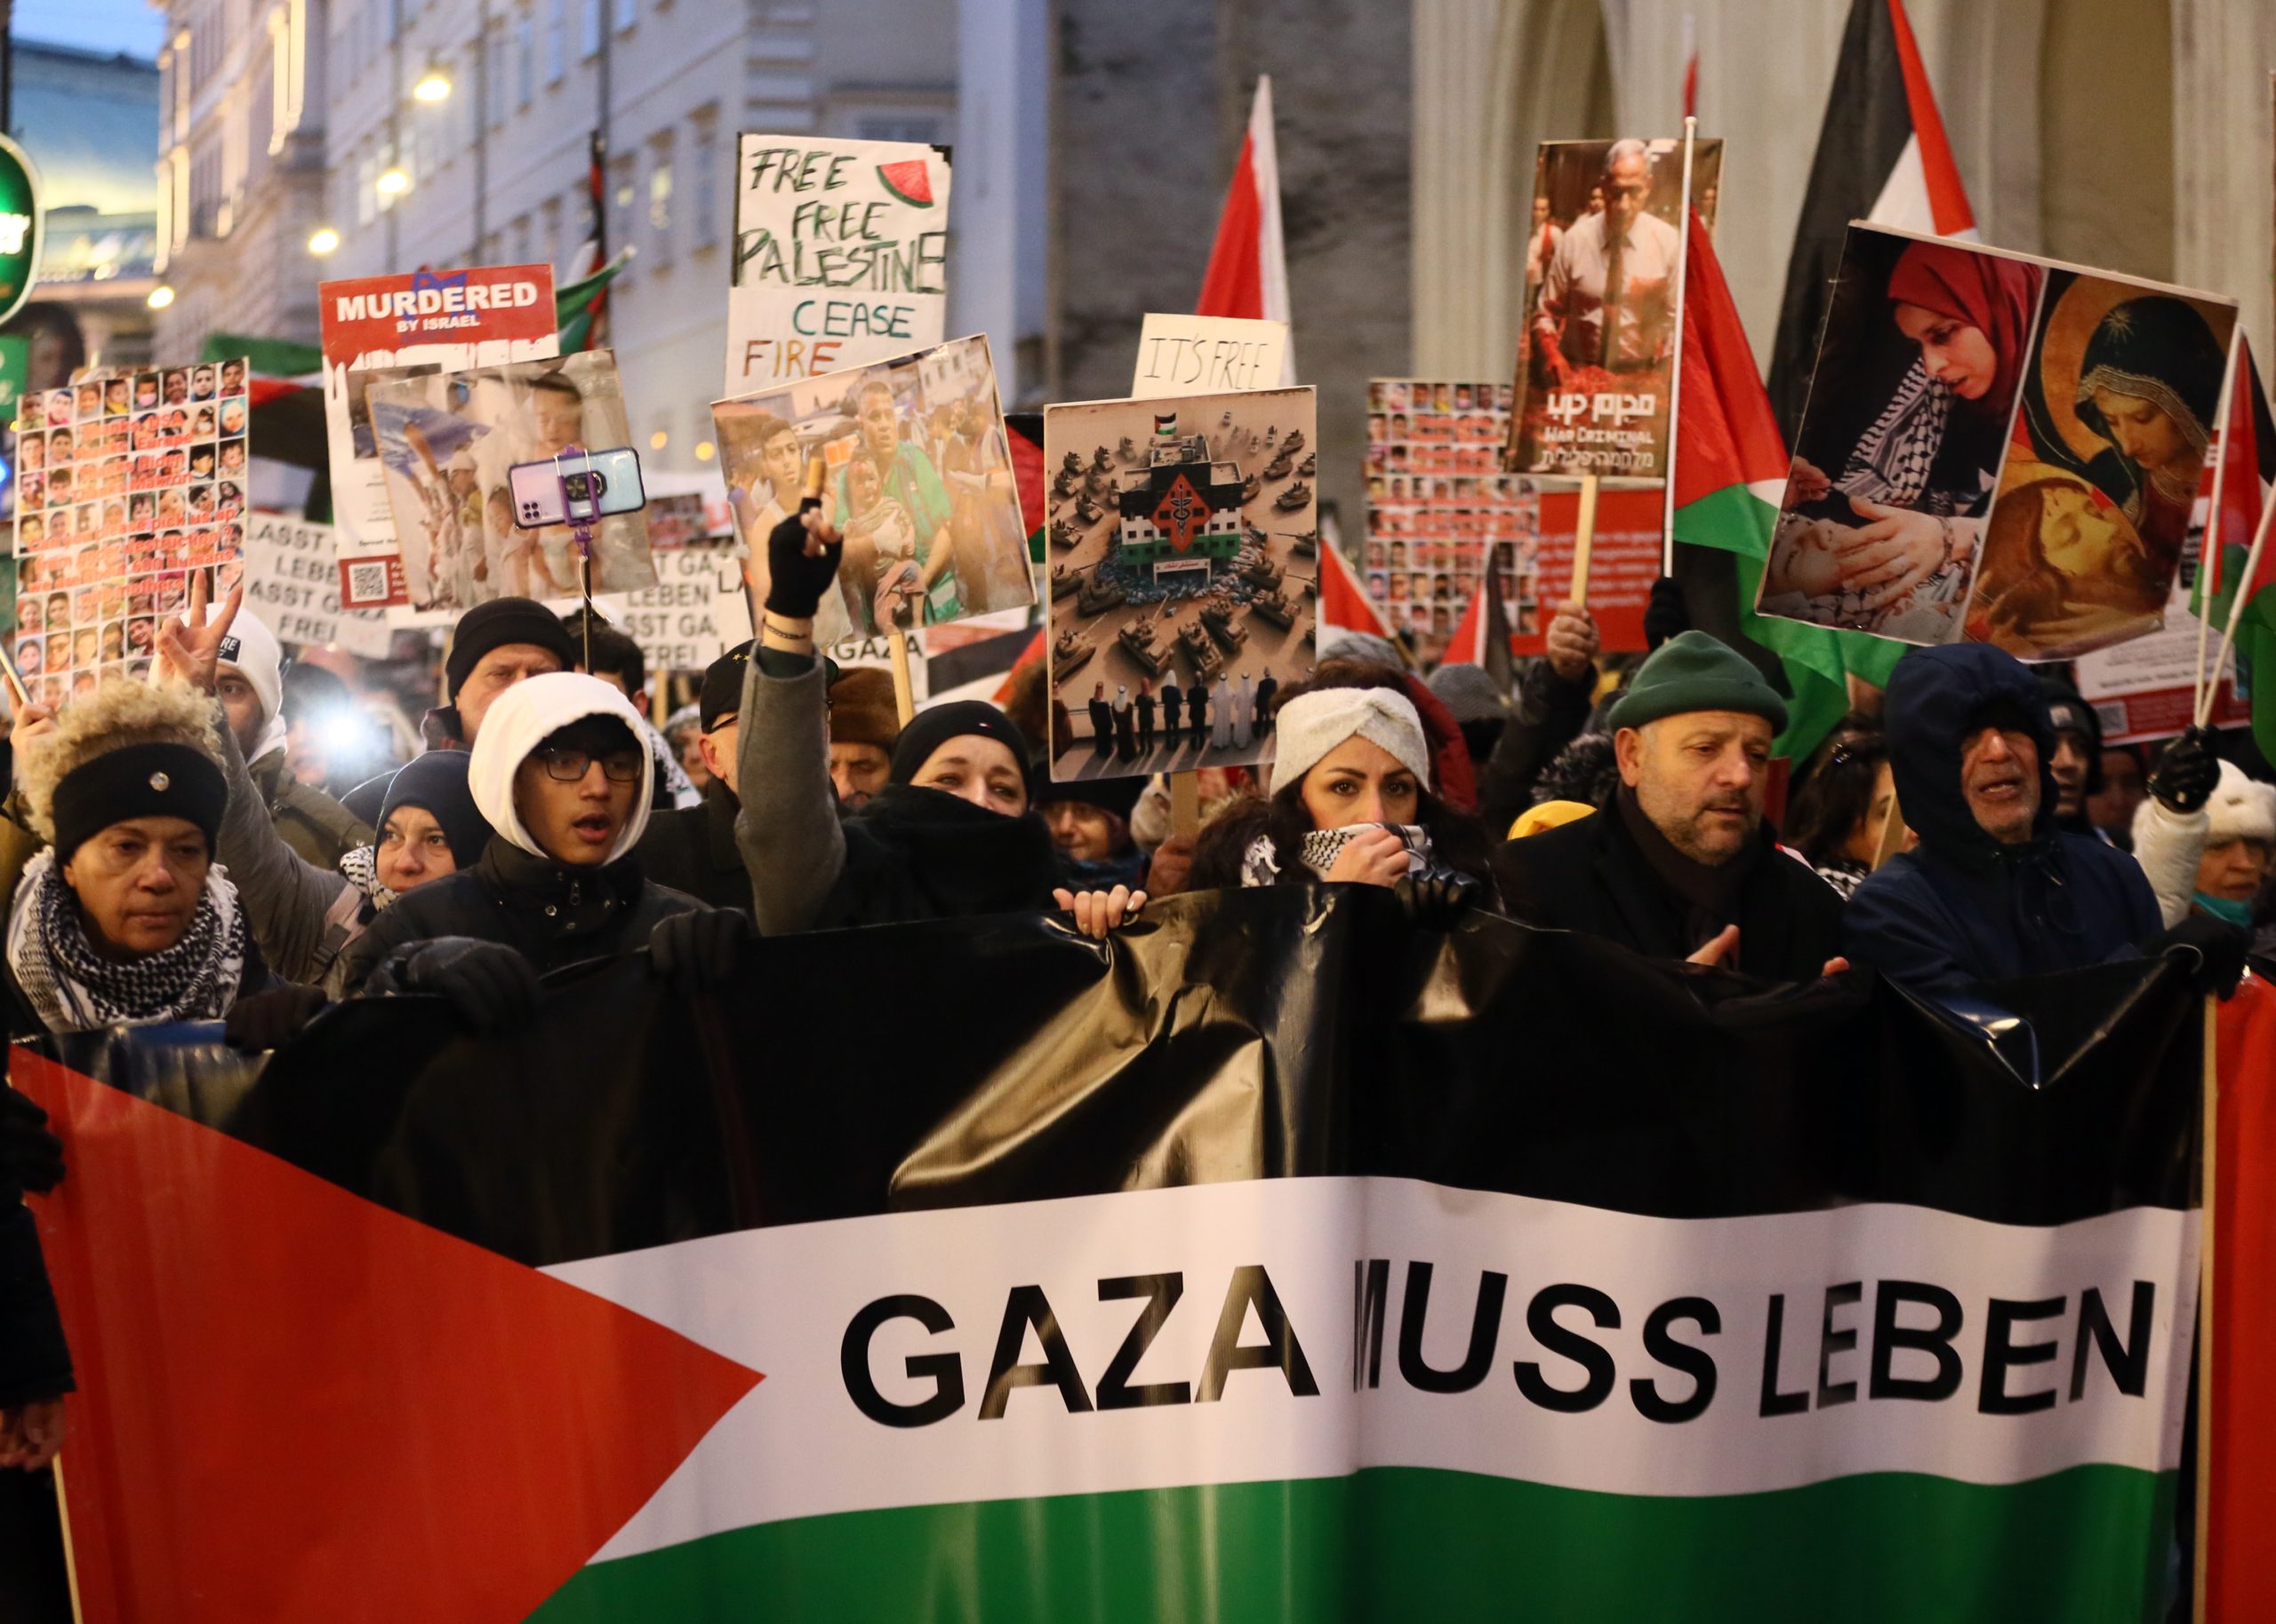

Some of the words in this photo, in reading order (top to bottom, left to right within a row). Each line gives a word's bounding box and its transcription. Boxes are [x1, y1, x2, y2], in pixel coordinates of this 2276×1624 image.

[749, 148, 857, 194] FREE
[791, 200, 892, 243] FREE
[736, 228, 947, 294] PALESTINE
[335, 281, 539, 323] MURDERED
[792, 300, 917, 339] CEASE
[396, 319, 419, 333] BY
[422, 315, 481, 332] ISRAEL
[742, 340, 843, 378] FIRE
[1143, 332, 1207, 385] IT'S
[1207, 340, 1270, 390] FREE
[275, 554, 339, 586] LEBE
[248, 580, 316, 610] ASST
[626, 582, 711, 608] LEBEN
[278, 614, 339, 643] FREI
[840, 1264, 1321, 1428] GAZA
[1353, 1258, 1722, 1424] MUSS
[1759, 1279, 2156, 1419] LEBEN
